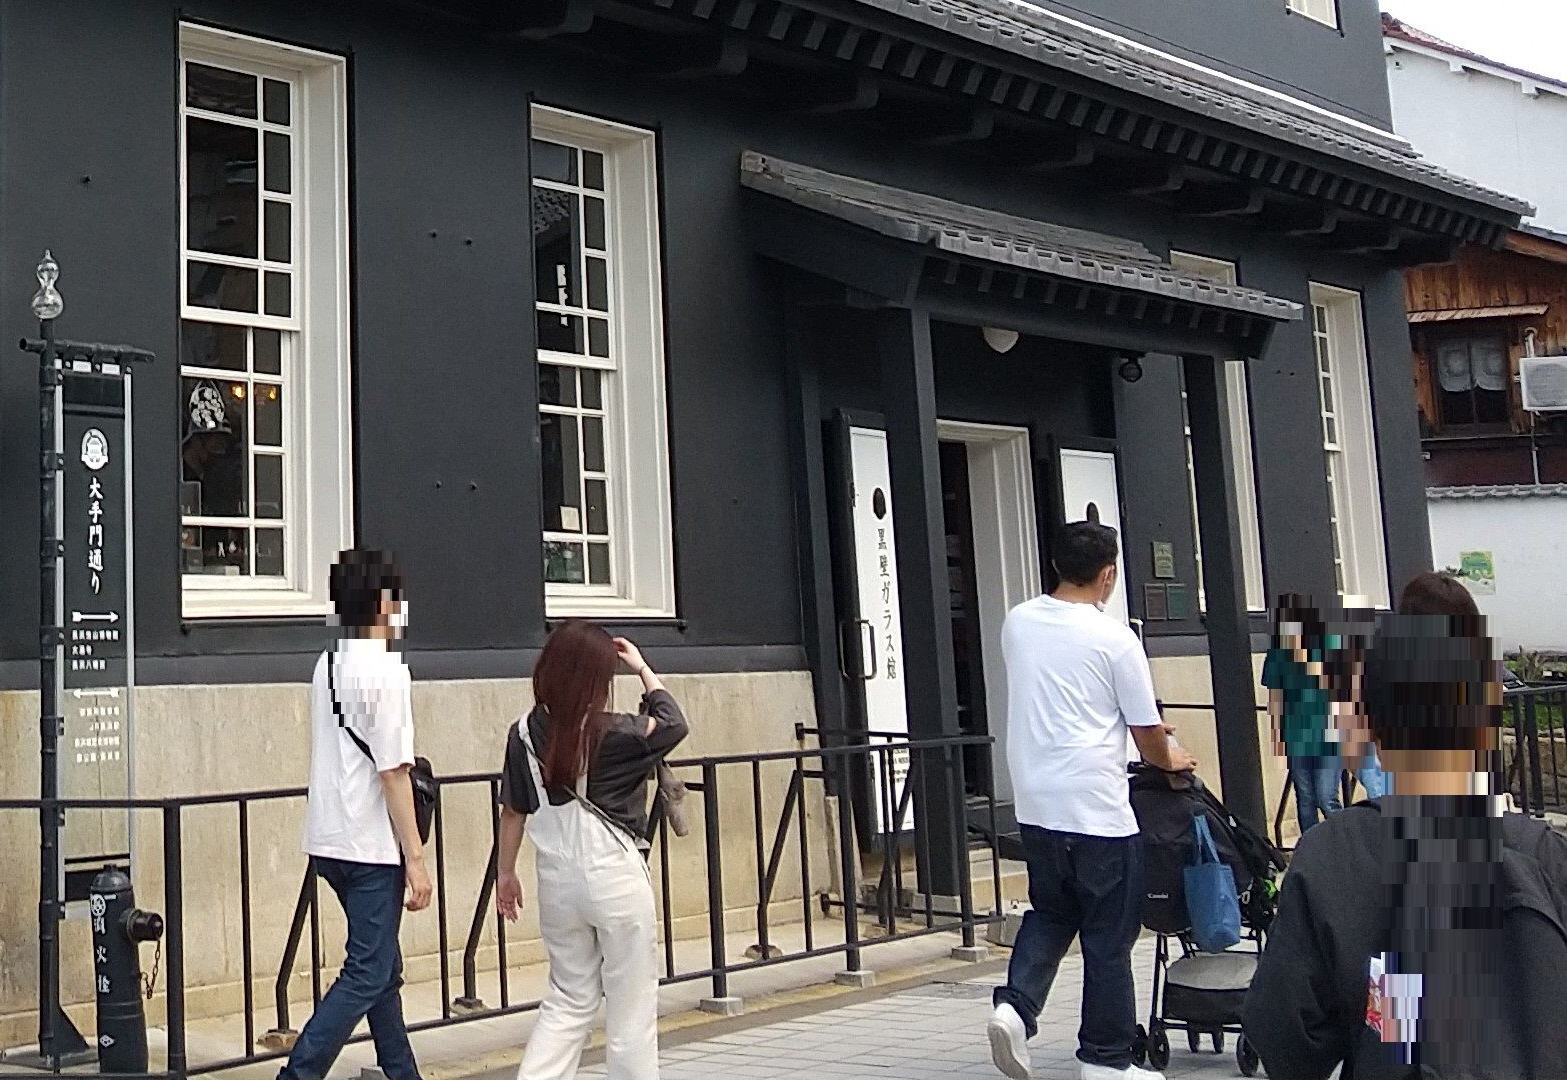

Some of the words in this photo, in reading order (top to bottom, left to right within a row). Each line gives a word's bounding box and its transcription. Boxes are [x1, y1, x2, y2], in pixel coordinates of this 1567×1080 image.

[88, 476, 104, 595] 大手門通り
[877, 527, 896, 680] 黒壁ガラス館
